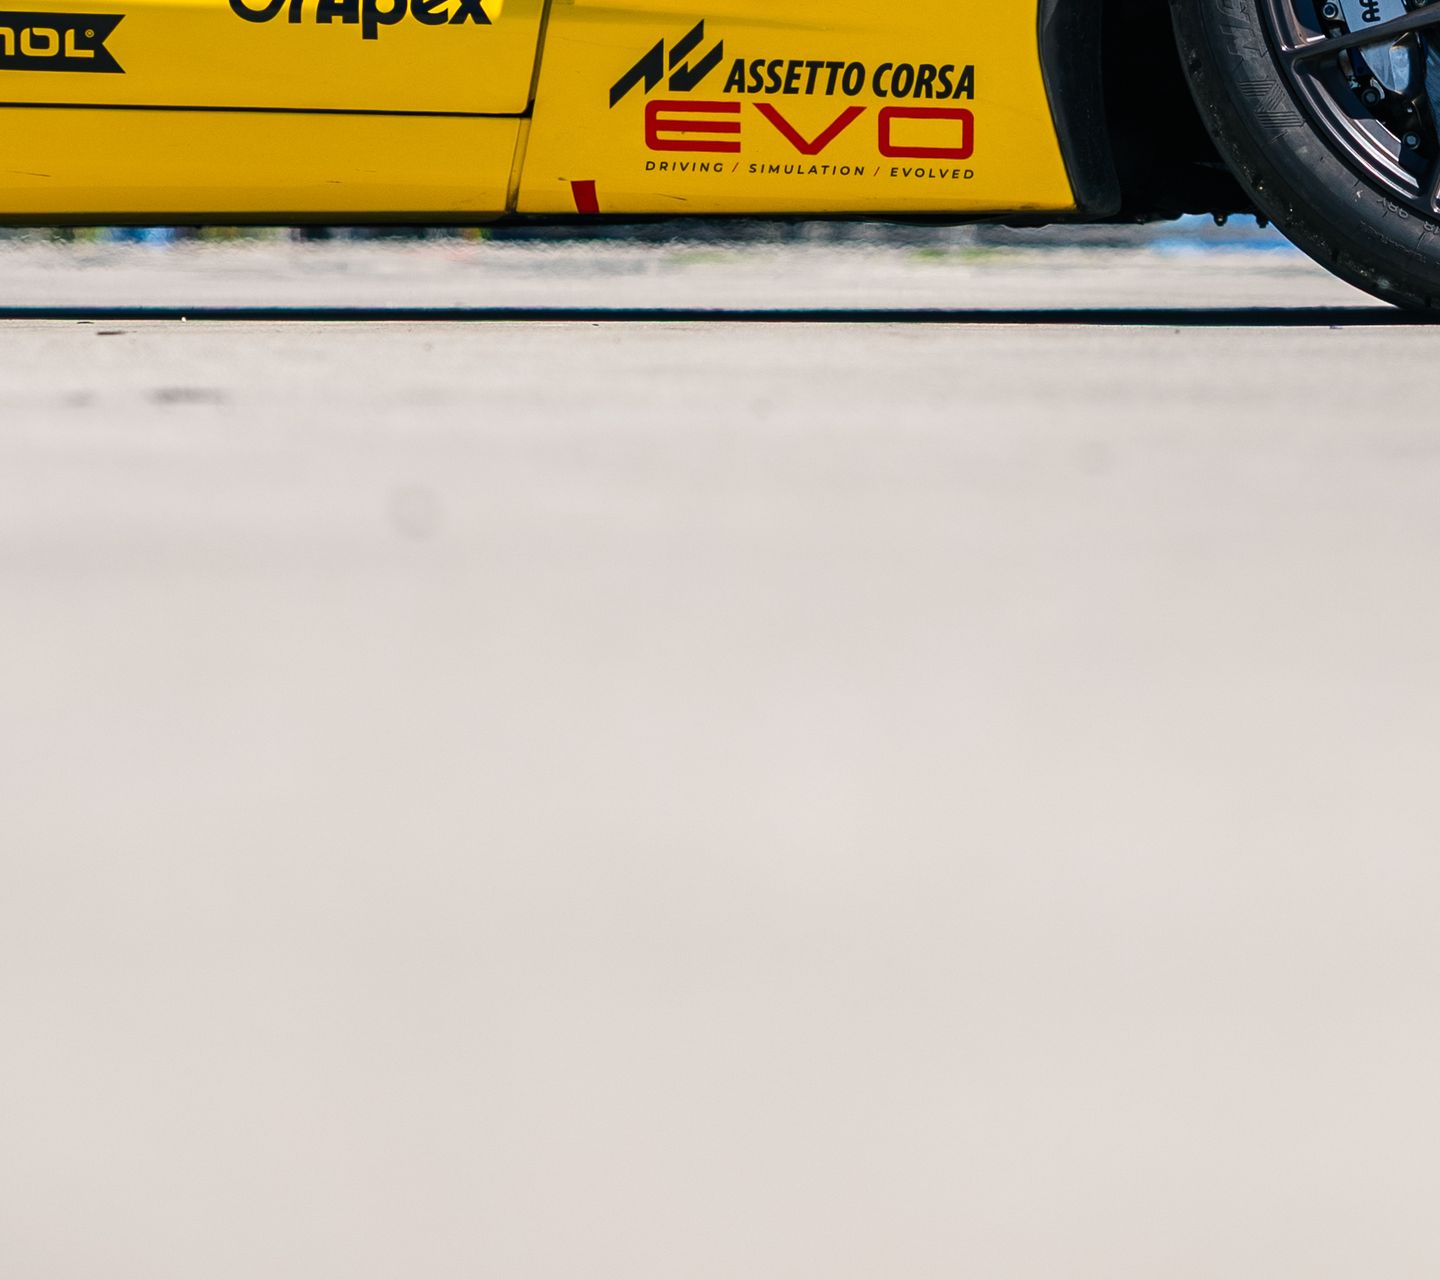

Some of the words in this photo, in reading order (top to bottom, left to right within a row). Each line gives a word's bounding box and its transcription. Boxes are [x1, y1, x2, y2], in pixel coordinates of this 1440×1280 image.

[723, 58, 867, 96] ASSETTO
[872, 62, 975, 100] CORSA
[644, 100, 974, 159] EVO
[645, 161, 724, 173] DRIVING
[749, 163, 865, 176] SIMULATION
[890, 167, 974, 179] EVOLVED
